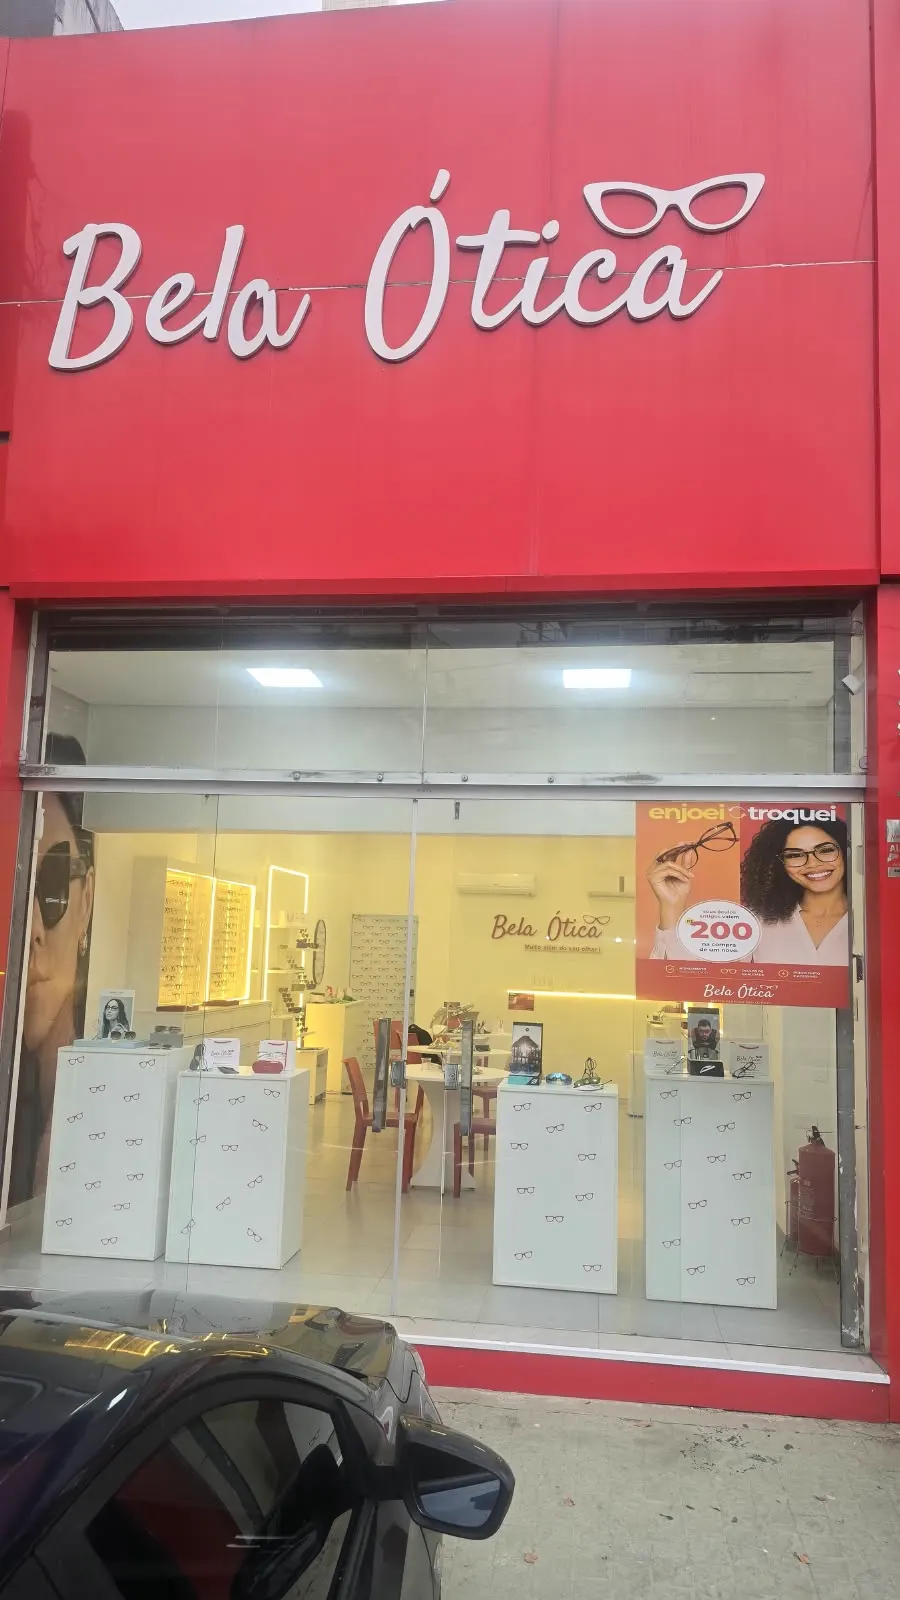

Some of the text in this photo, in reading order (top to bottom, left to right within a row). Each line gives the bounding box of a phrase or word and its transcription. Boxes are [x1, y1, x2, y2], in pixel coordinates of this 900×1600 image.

[47, 168, 724, 371] Bela Ótica
[649, 804, 836, 824] enjoei troquei
[491, 910, 602, 941] Bela Ótica
[690, 921, 753, 940] 200
[703, 983, 775, 999] Bela Ótica
